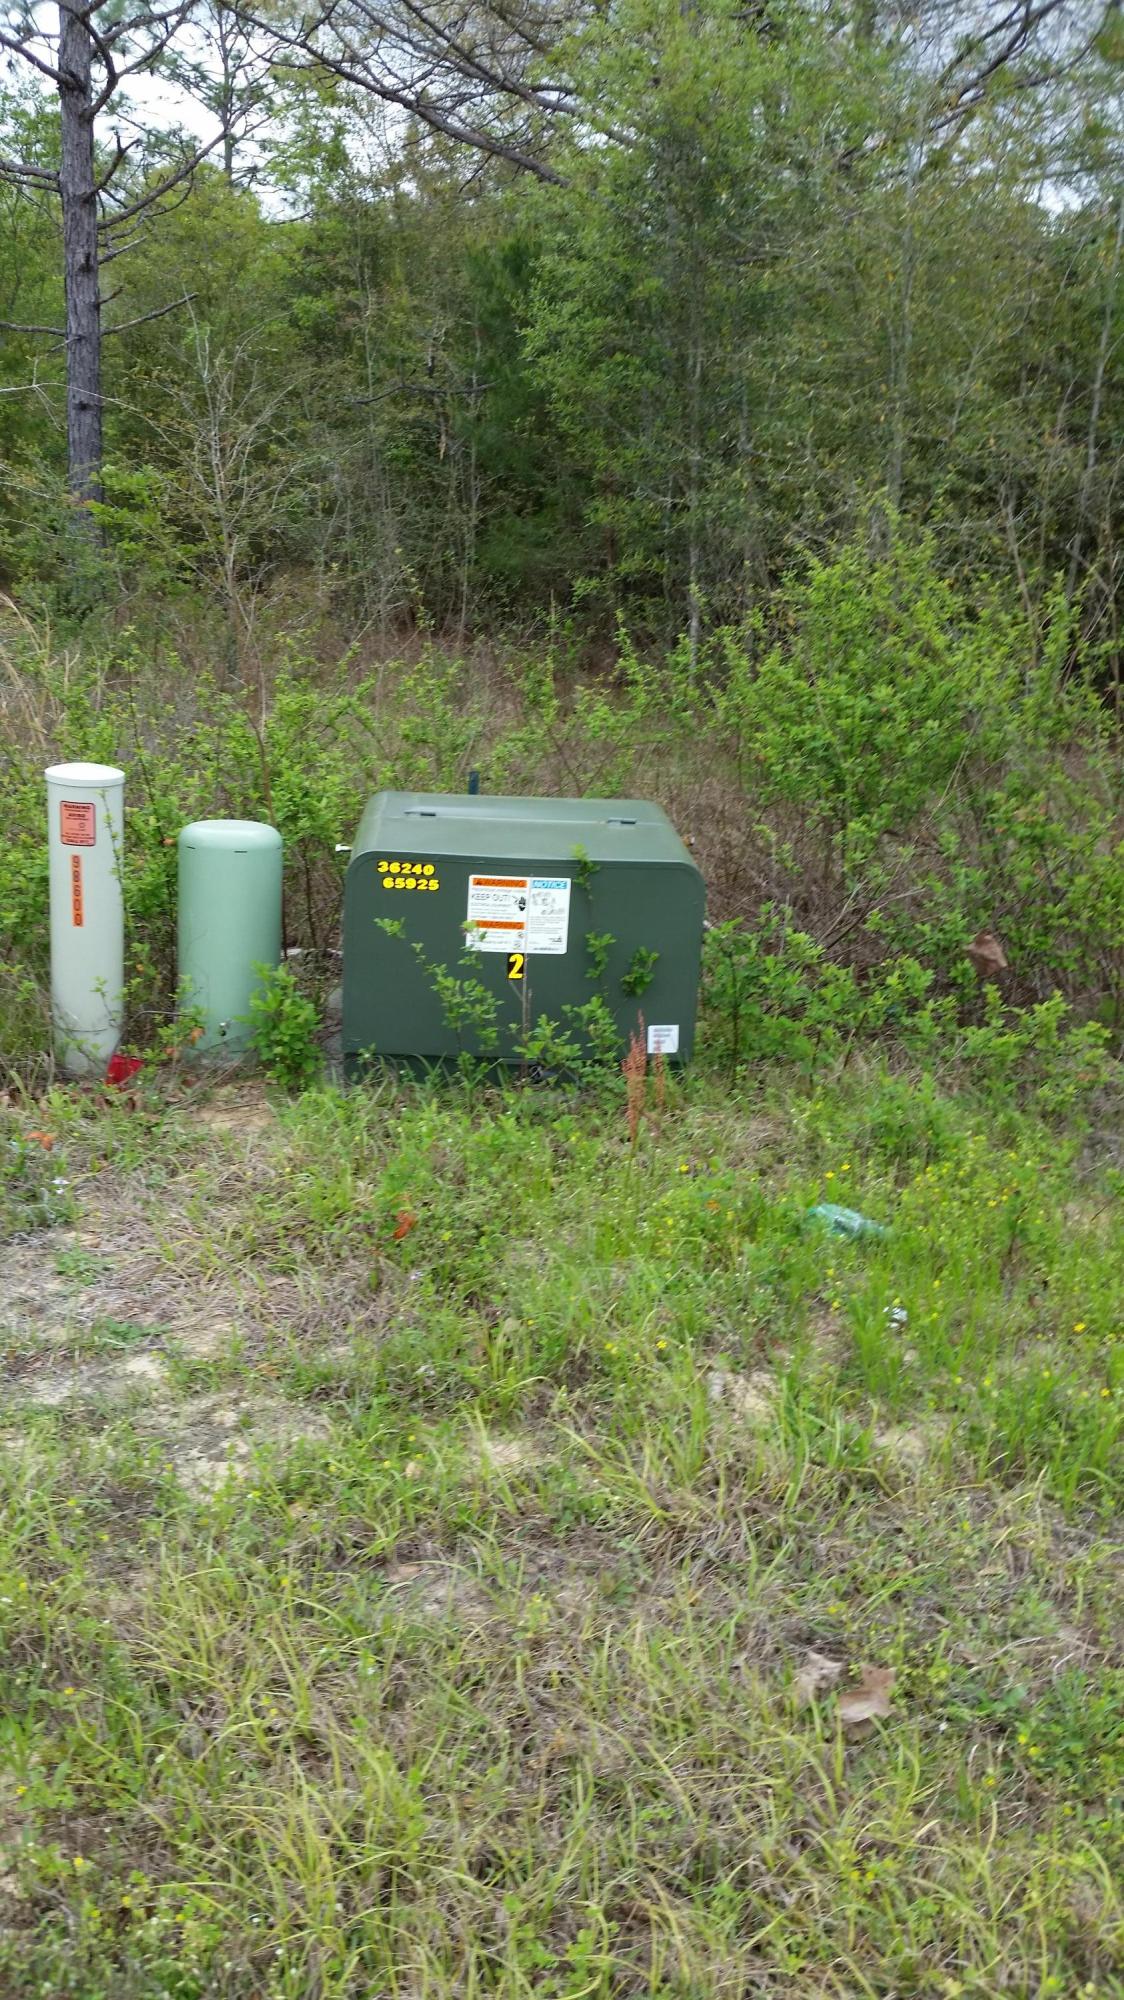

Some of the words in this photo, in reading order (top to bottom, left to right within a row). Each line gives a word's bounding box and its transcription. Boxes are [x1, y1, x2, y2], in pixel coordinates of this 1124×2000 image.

[377, 861, 435, 876] 36240
[382, 877, 440, 891] 65925
[532, 880, 567, 889] NOTICE
[471, 893, 490, 901] KEEP
[508, 953, 523, 978] 2
